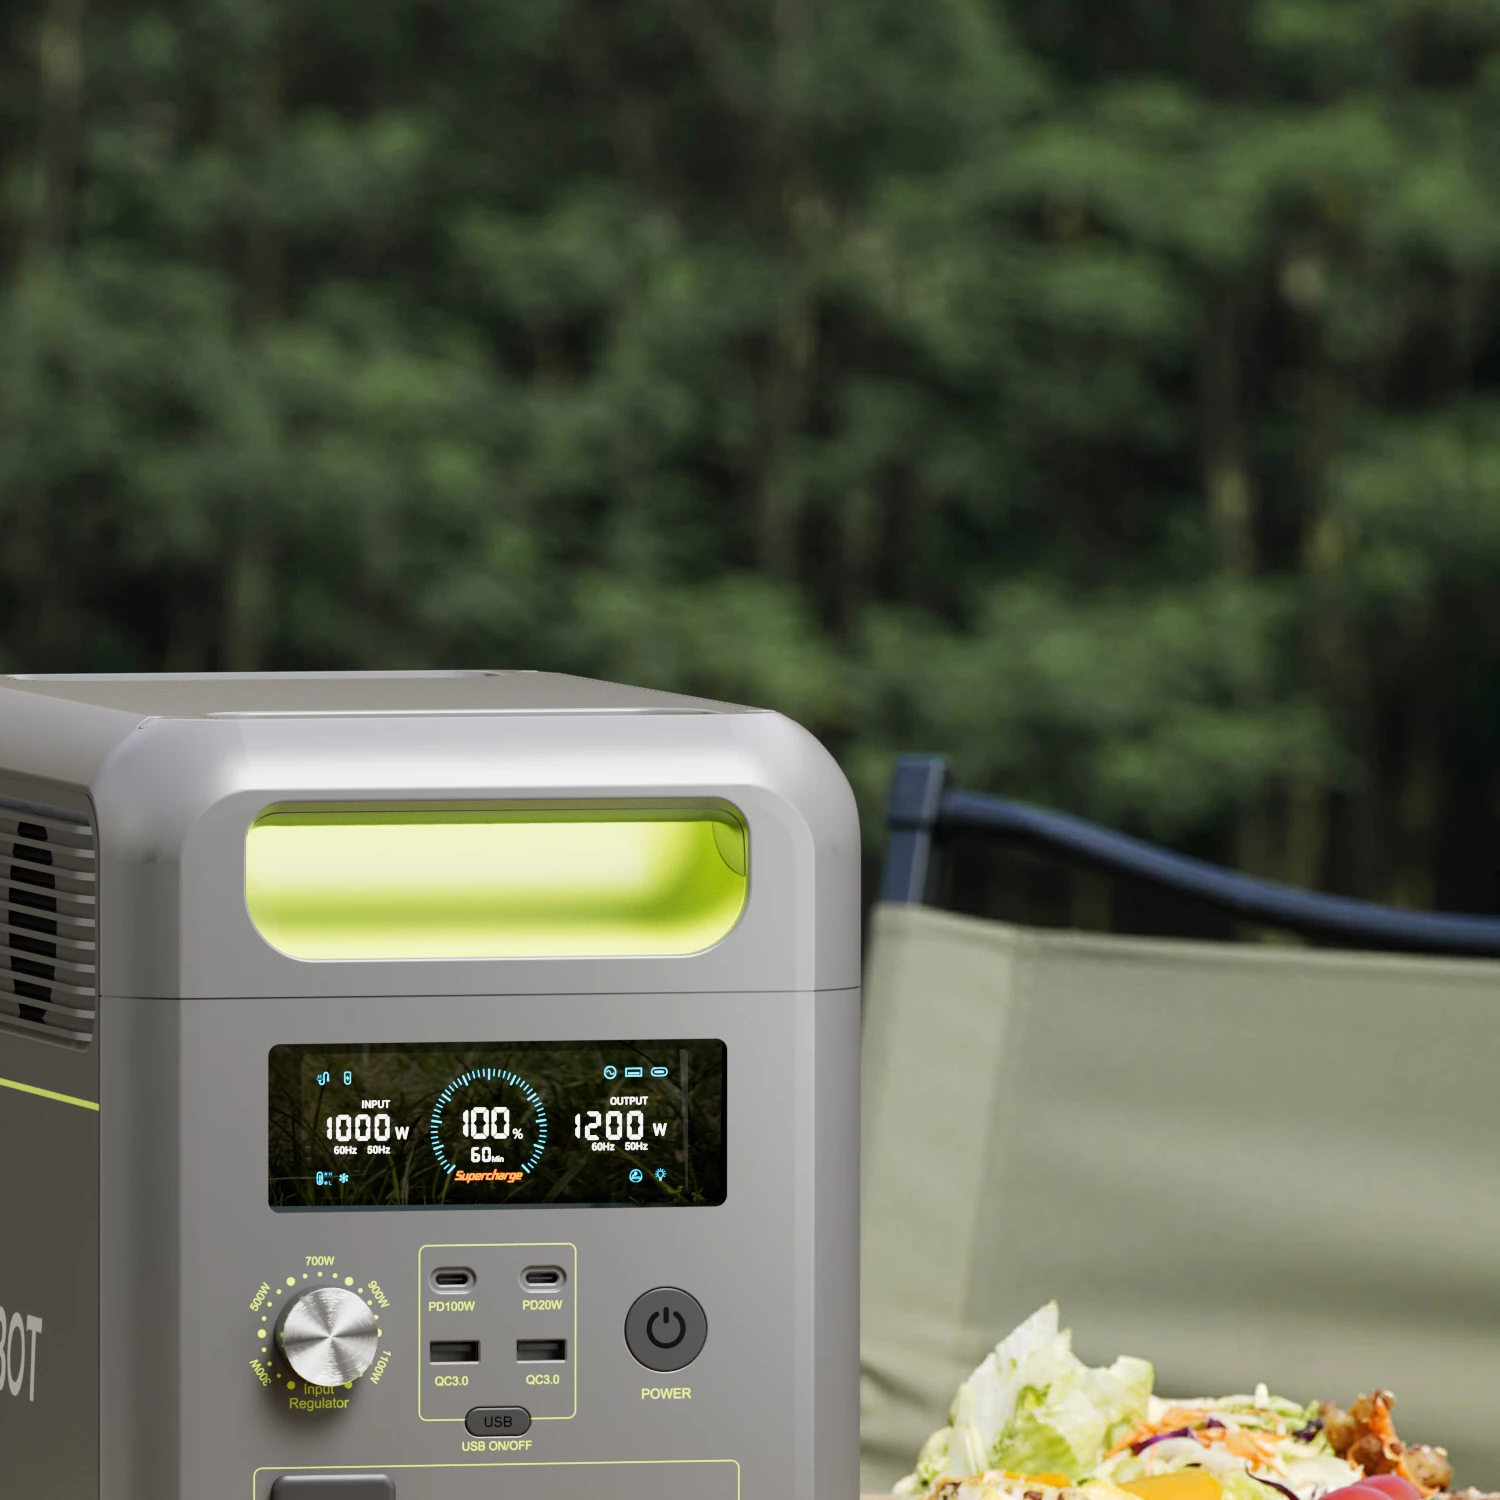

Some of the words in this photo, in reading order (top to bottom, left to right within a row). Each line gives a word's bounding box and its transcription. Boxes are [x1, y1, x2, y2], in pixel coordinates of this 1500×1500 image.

[361, 1099, 391, 1109] INPUT
[609, 1095, 649, 1106] OUTPUT
[326, 1113, 391, 1142] 1000
[394, 1125, 410, 1140] W
[574, 1110, 644, 1141] 1200
[652, 1122, 668, 1137] W
[333, 1145, 358, 1155] 60Hz
[366, 1145, 391, 1155] 50Hz
[591, 1141, 616, 1151] 60Hz
[624, 1141, 649, 1151] 50Hz
[454, 1168, 524, 1184] Supercharge
[305, 1255, 335, 1266] 700W
[249, 1281, 271, 1312] 500W
[367, 1280, 390, 1309] 900W
[428, 1300, 476, 1313] PD100W
[522, 1298, 564, 1311] PD20W
[249, 1358, 272, 1387] 300W
[369, 1350, 392, 1385] 1100W
[434, 1375, 470, 1387] QC3.0
[525, 1373, 561, 1386] QC3.0
[304, 1384, 335, 1397] Input
[641, 1387, 692, 1401] POWER
[289, 1398, 350, 1412] Regulator
[483, 1415, 513, 1429] USB
[461, 1441, 485, 1453] USB
[488, 1440, 533, 1453] ON/OFF
